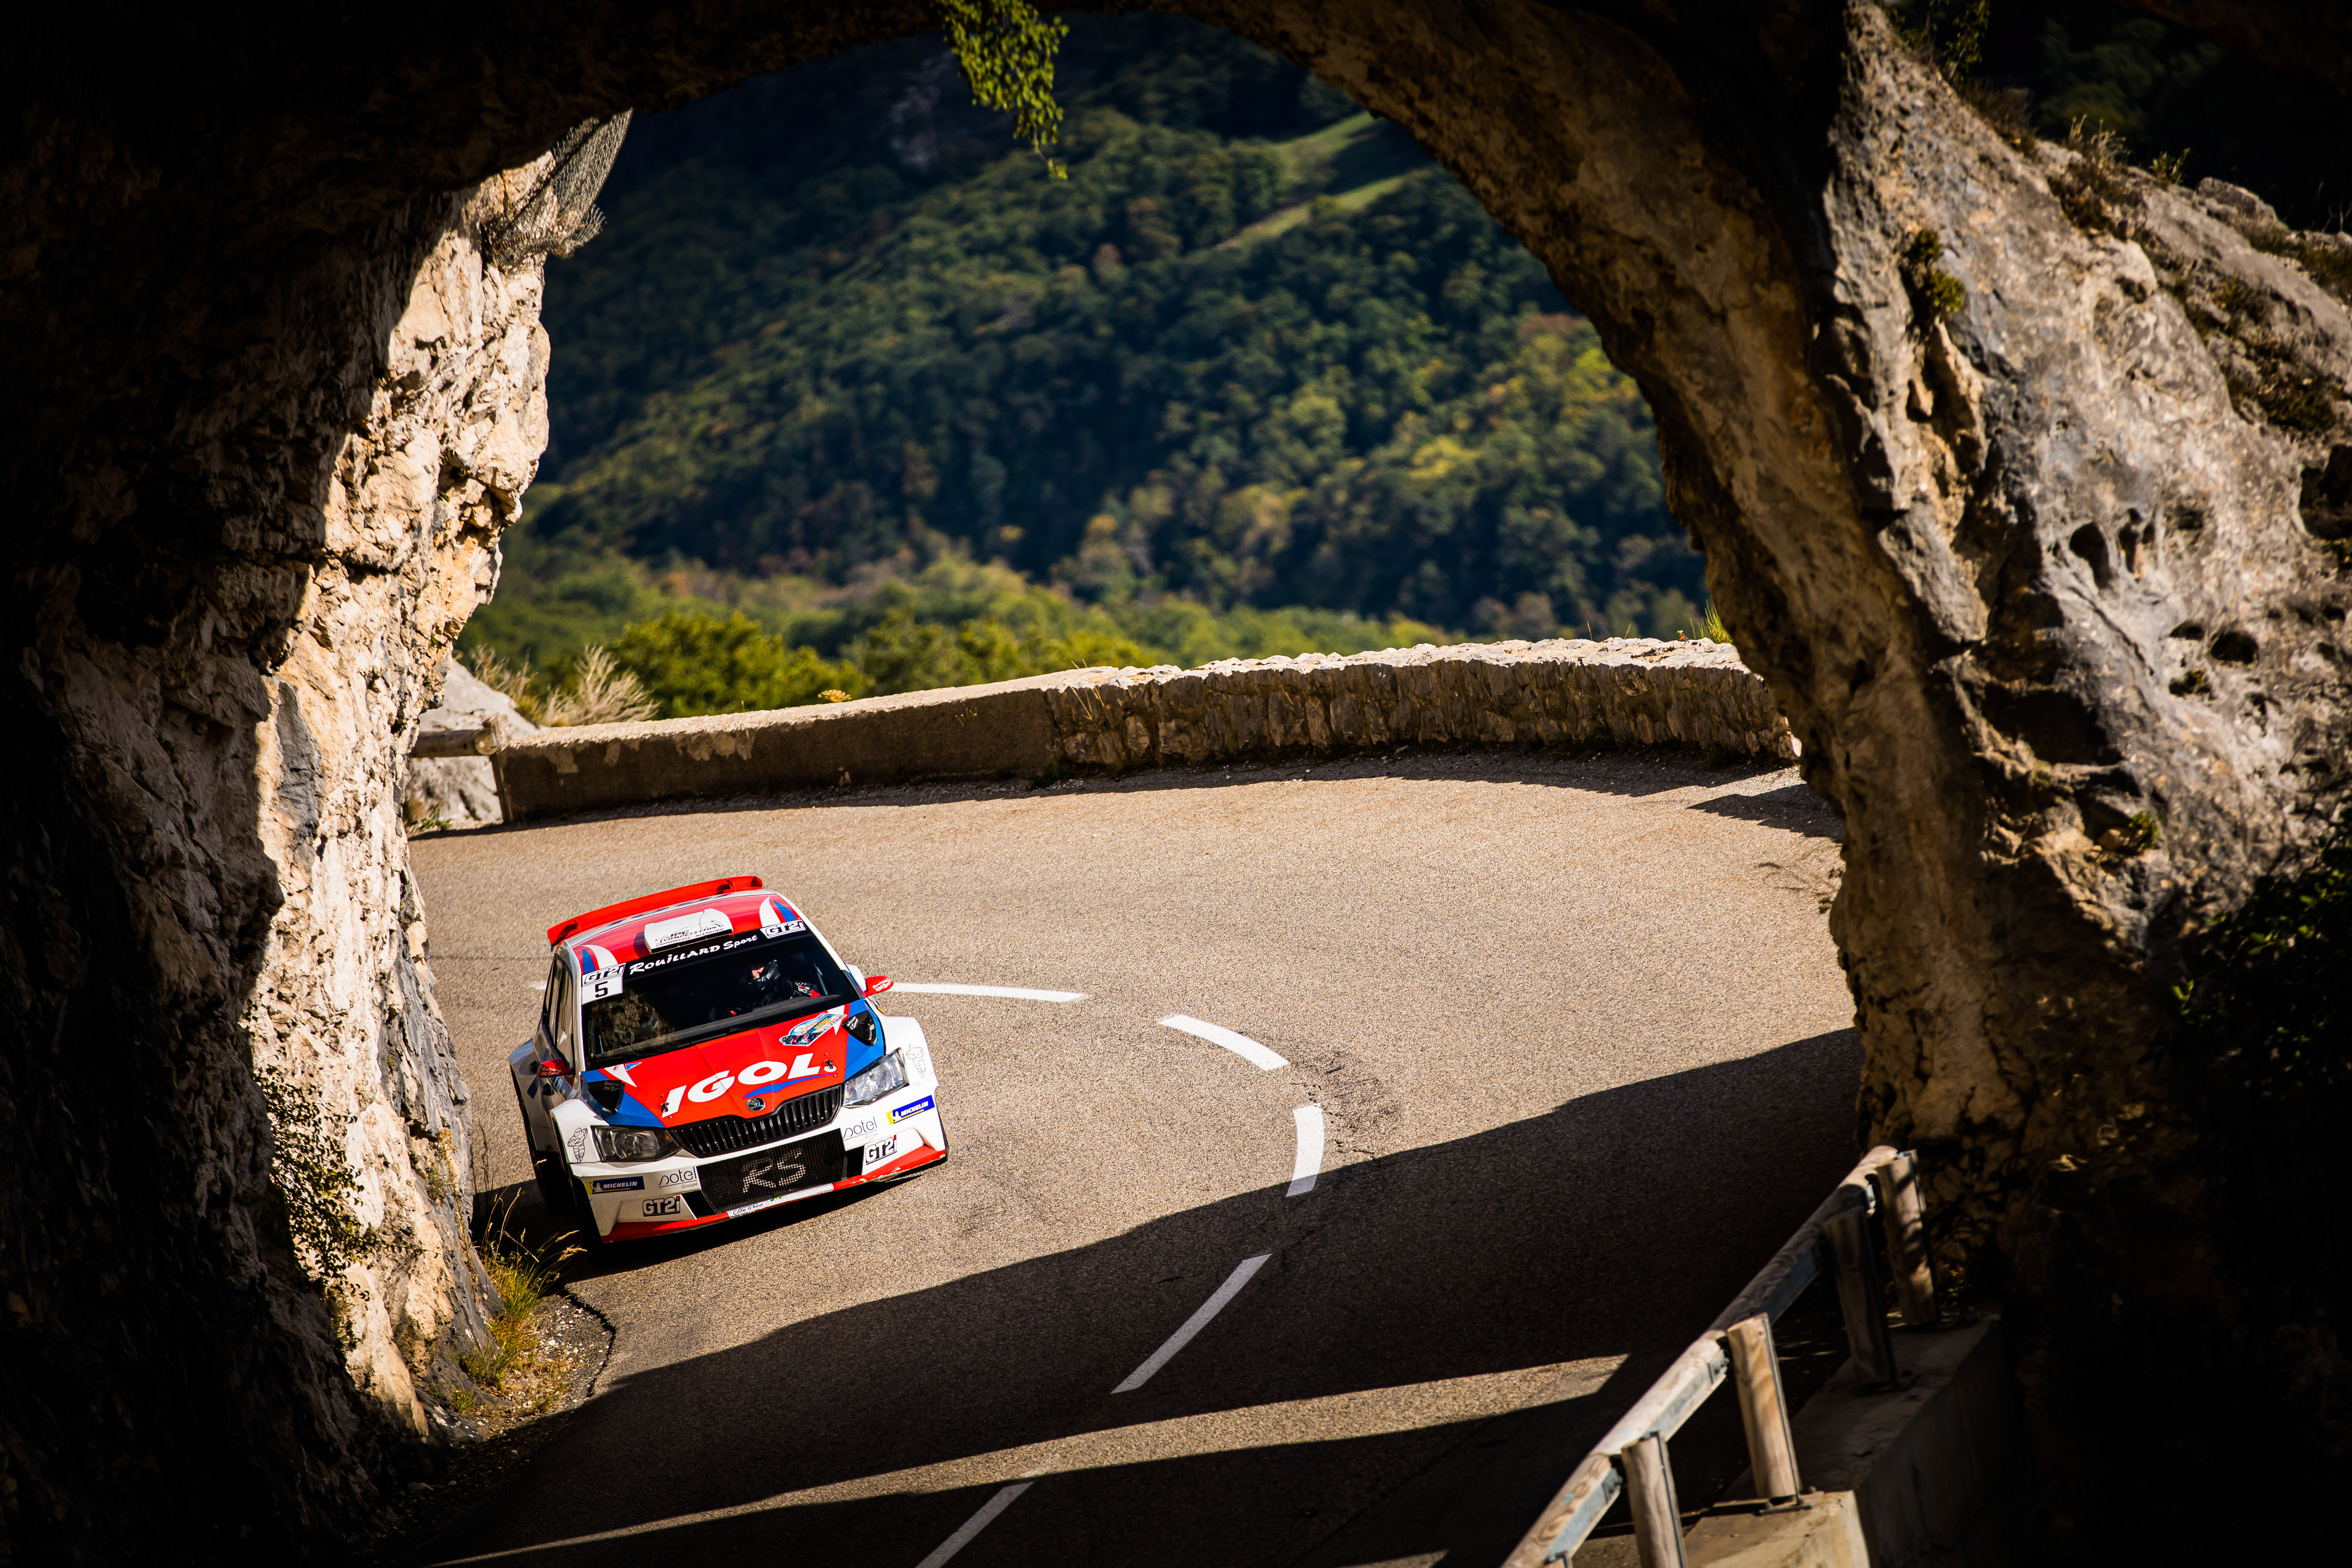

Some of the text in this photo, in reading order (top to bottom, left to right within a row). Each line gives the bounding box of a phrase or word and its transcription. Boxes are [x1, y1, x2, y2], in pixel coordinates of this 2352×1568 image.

[766, 921, 805, 936] GT2i
[723, 935, 758, 950] Sport
[584, 964, 625, 984] GT2i
[595, 981, 608, 998] 5
[901, 1101, 928, 1117] MICHELIN
[865, 1134, 897, 1163] GT2i
[642, 1195, 681, 1215] GT2i
